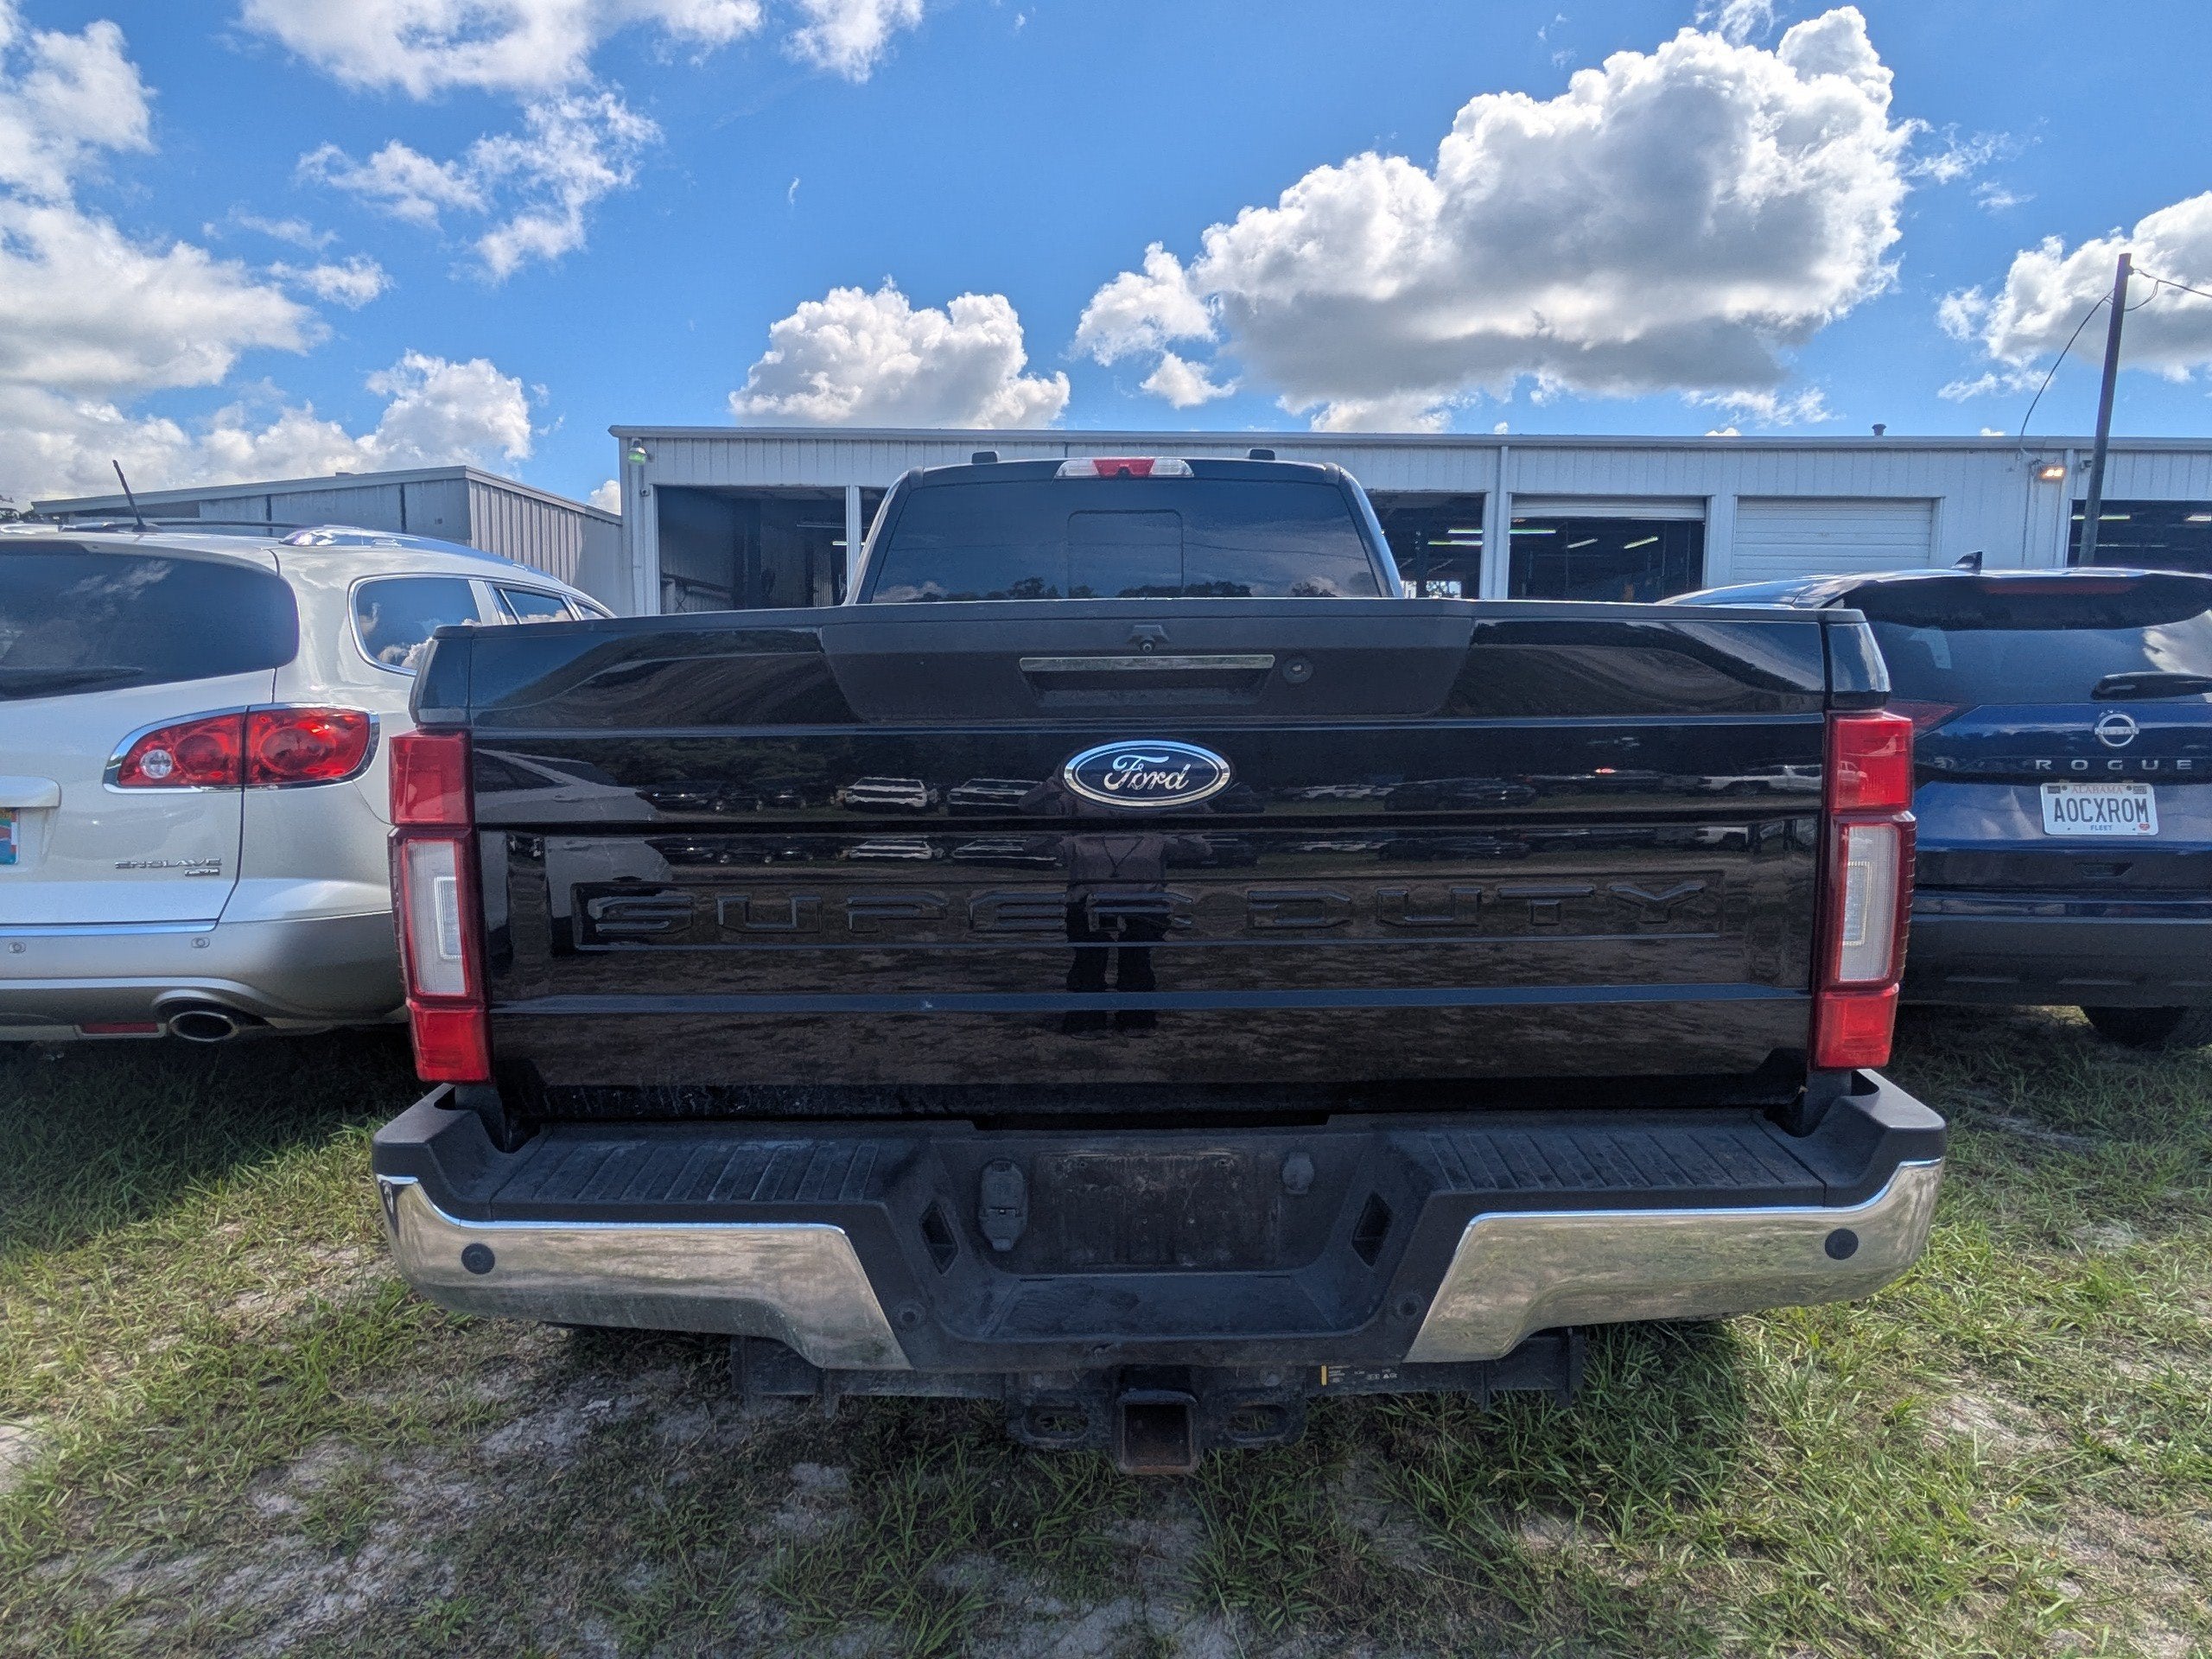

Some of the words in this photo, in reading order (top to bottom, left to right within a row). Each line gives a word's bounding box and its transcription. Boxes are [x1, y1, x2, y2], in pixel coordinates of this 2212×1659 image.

[1103, 754, 1191, 791] Ford
[2035, 760, 2192, 770] ROGUE
[2072, 785, 2123, 794] ALABAMA
[589, 890, 1195, 933] SUPER
[1248, 881, 1706, 928] DUTY
